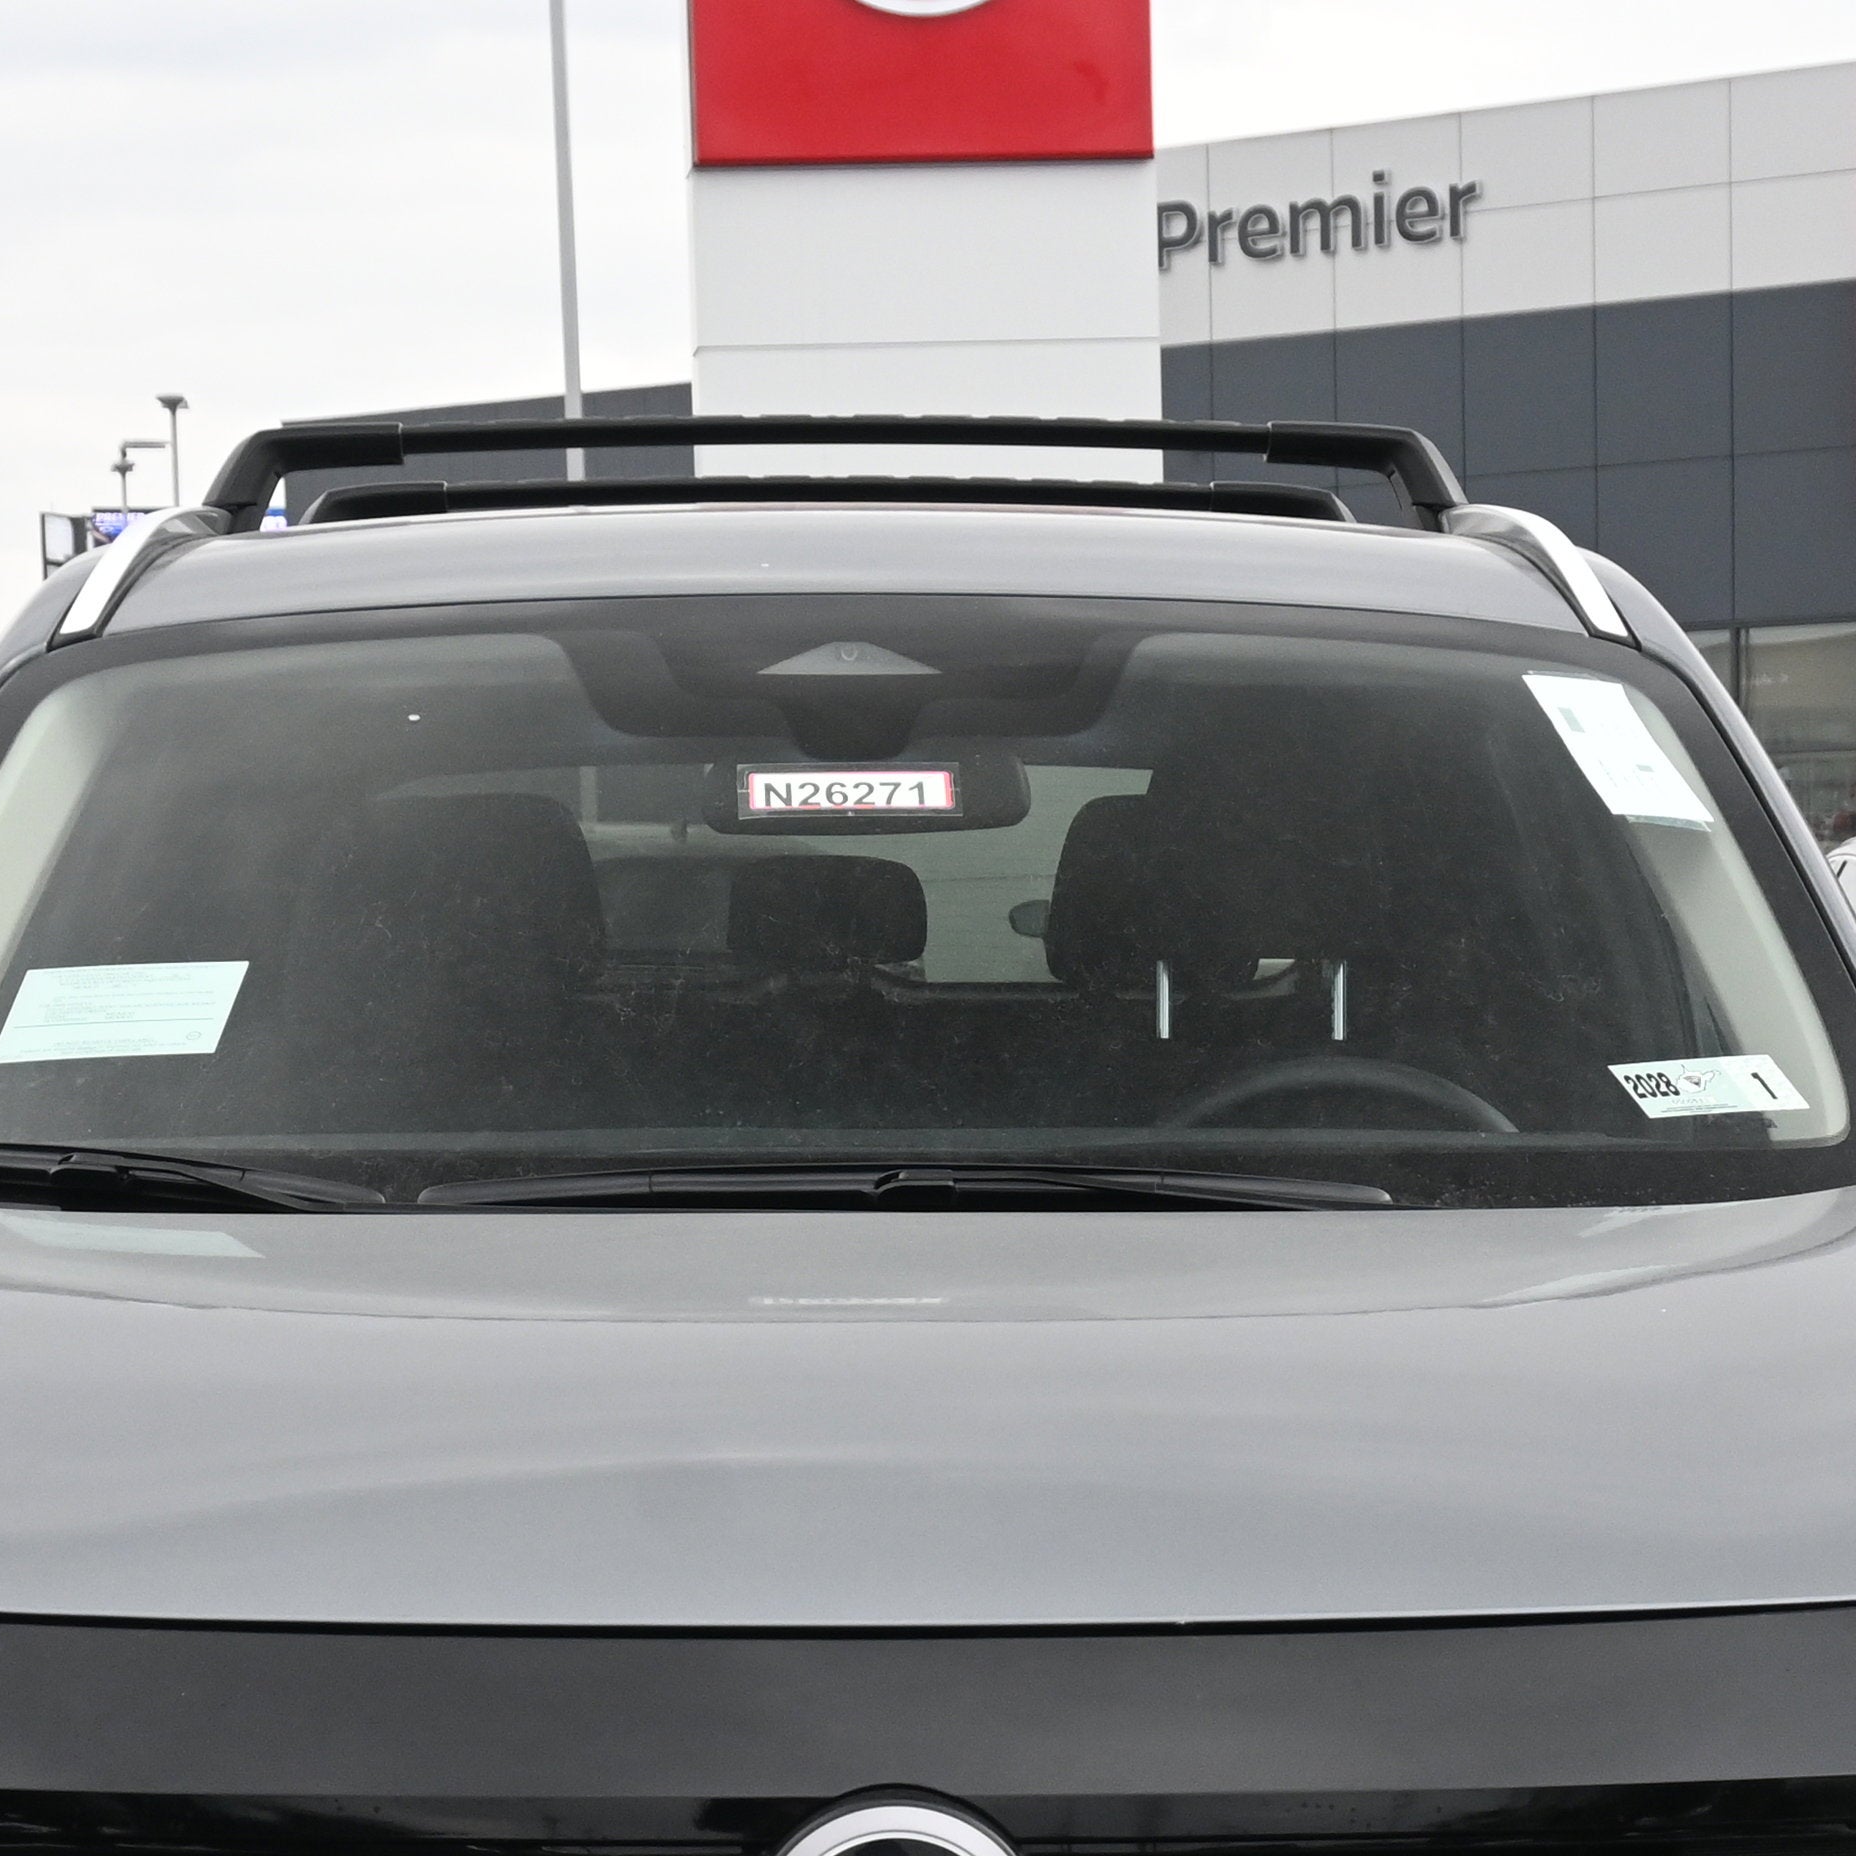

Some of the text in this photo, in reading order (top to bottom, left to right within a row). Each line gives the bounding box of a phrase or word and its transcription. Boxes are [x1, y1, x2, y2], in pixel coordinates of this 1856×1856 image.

[1157, 169, 1482, 270] Premier
[763, 781, 926, 807] N26271
[1623, 1072, 1778, 1100] 2028 1
